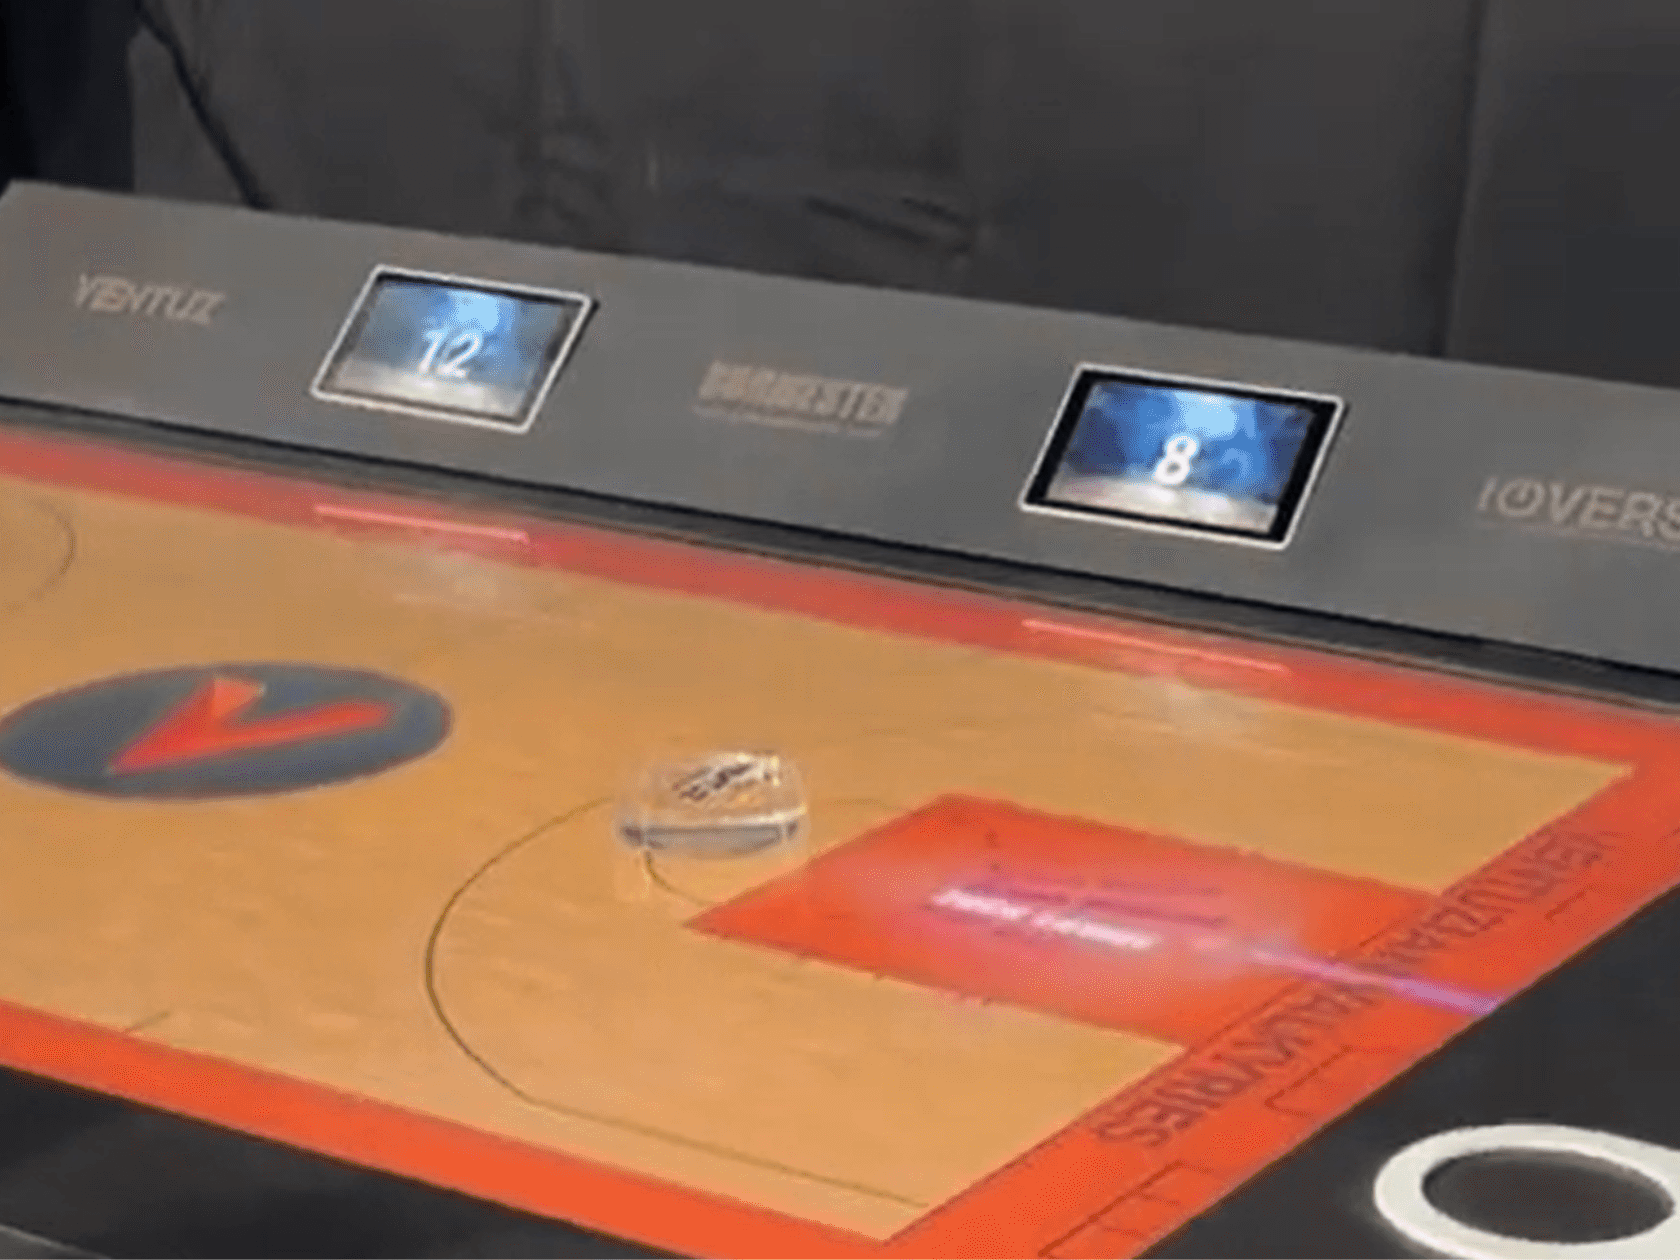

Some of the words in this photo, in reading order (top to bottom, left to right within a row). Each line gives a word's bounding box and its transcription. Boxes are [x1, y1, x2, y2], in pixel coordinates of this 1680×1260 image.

[75, 274, 225, 325] VENTUZ
[420, 329, 482, 377] 12
[1154, 433, 1199, 486] 8
